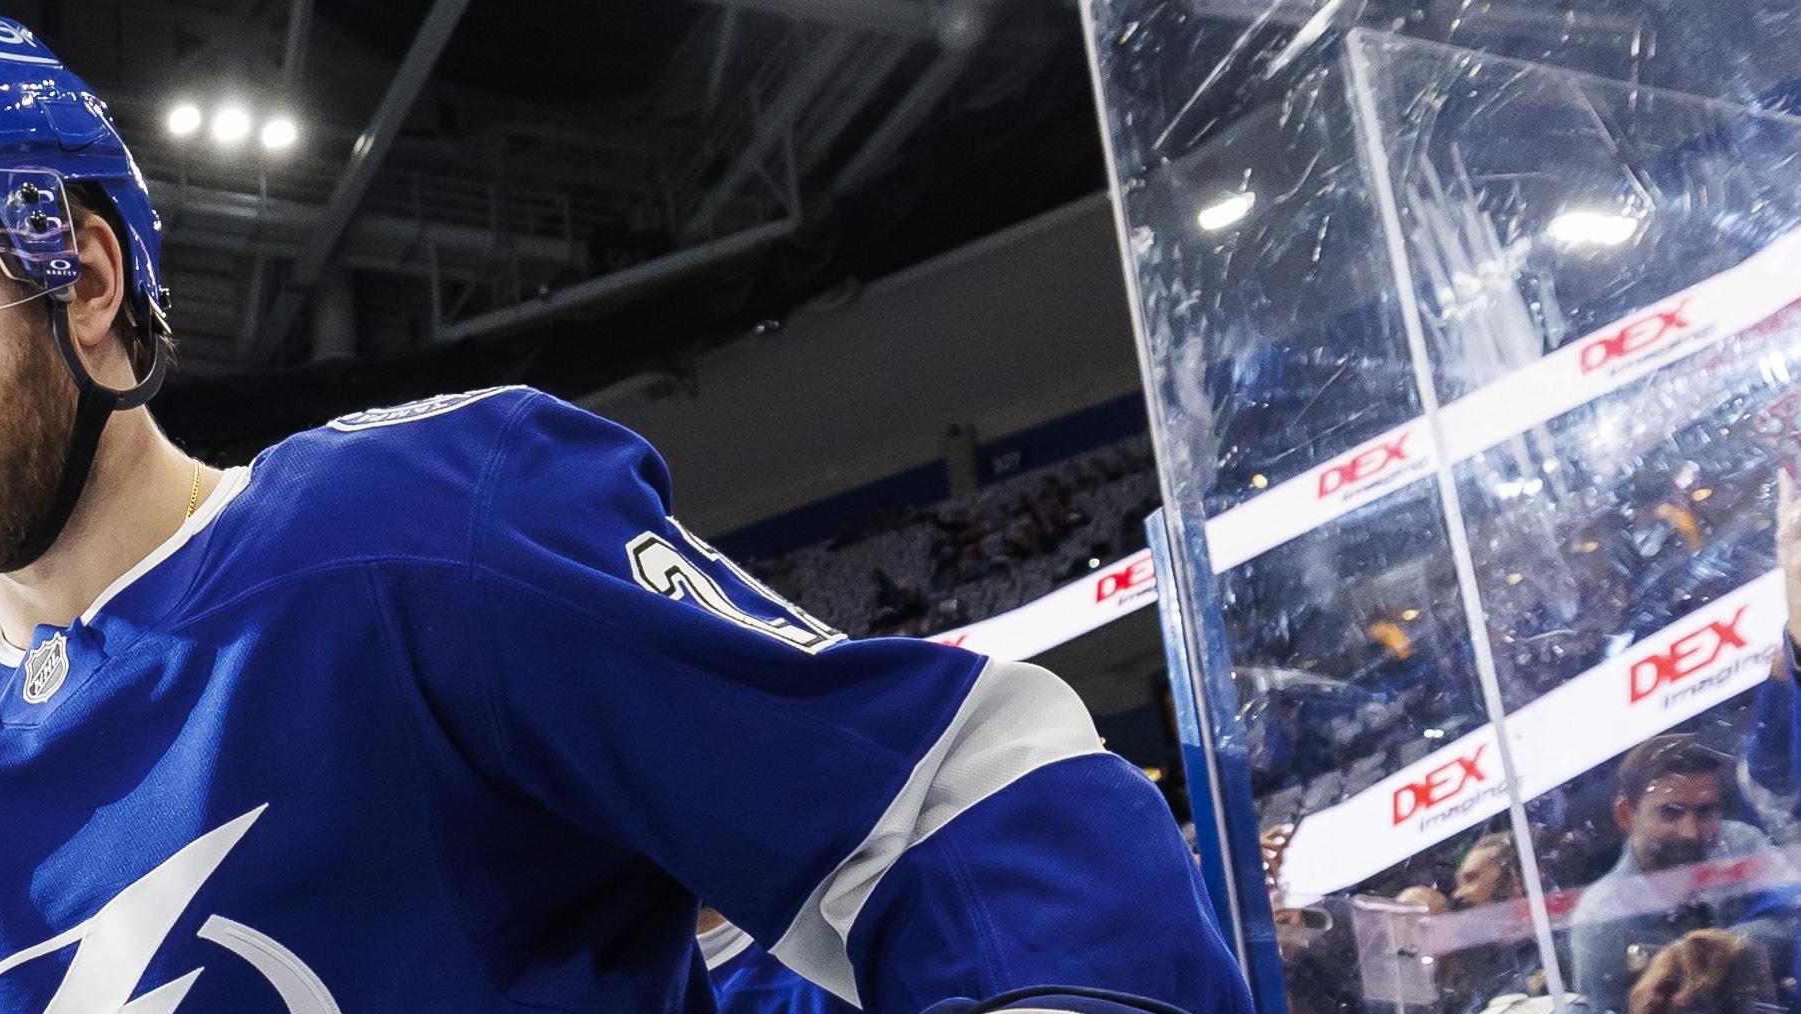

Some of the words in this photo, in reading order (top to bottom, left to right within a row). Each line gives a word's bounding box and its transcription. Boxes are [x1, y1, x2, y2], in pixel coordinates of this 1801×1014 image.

[1580, 298, 1693, 375] DEX
[1318, 430, 1412, 498] DEX
[1096, 555, 1155, 604] DE
[1630, 604, 1748, 704] DEX
[1393, 743, 1488, 826] DEX
